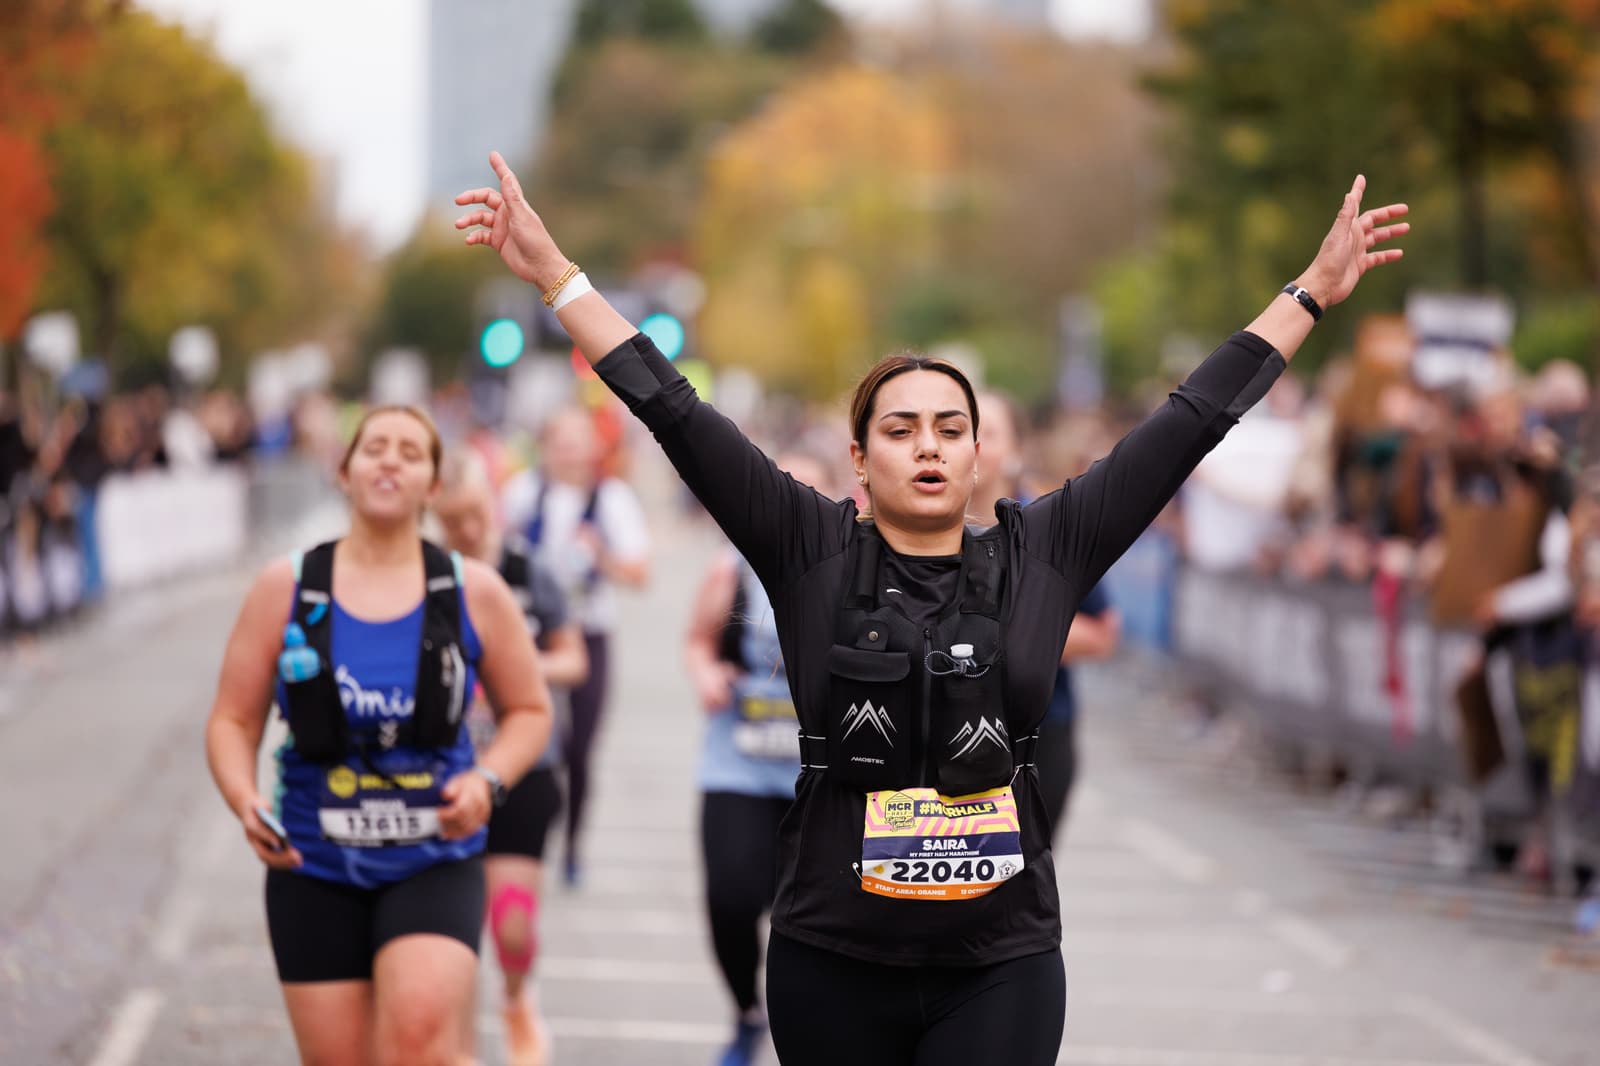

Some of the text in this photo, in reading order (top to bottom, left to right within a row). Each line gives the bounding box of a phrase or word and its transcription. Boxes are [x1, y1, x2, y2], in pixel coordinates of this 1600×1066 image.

[887, 802, 912, 812] MCR
[922, 838, 968, 851] SAIRA
[891, 859, 995, 883] 22040
[874, 883, 895, 893] START
[895, 888, 916, 896] AREA:
